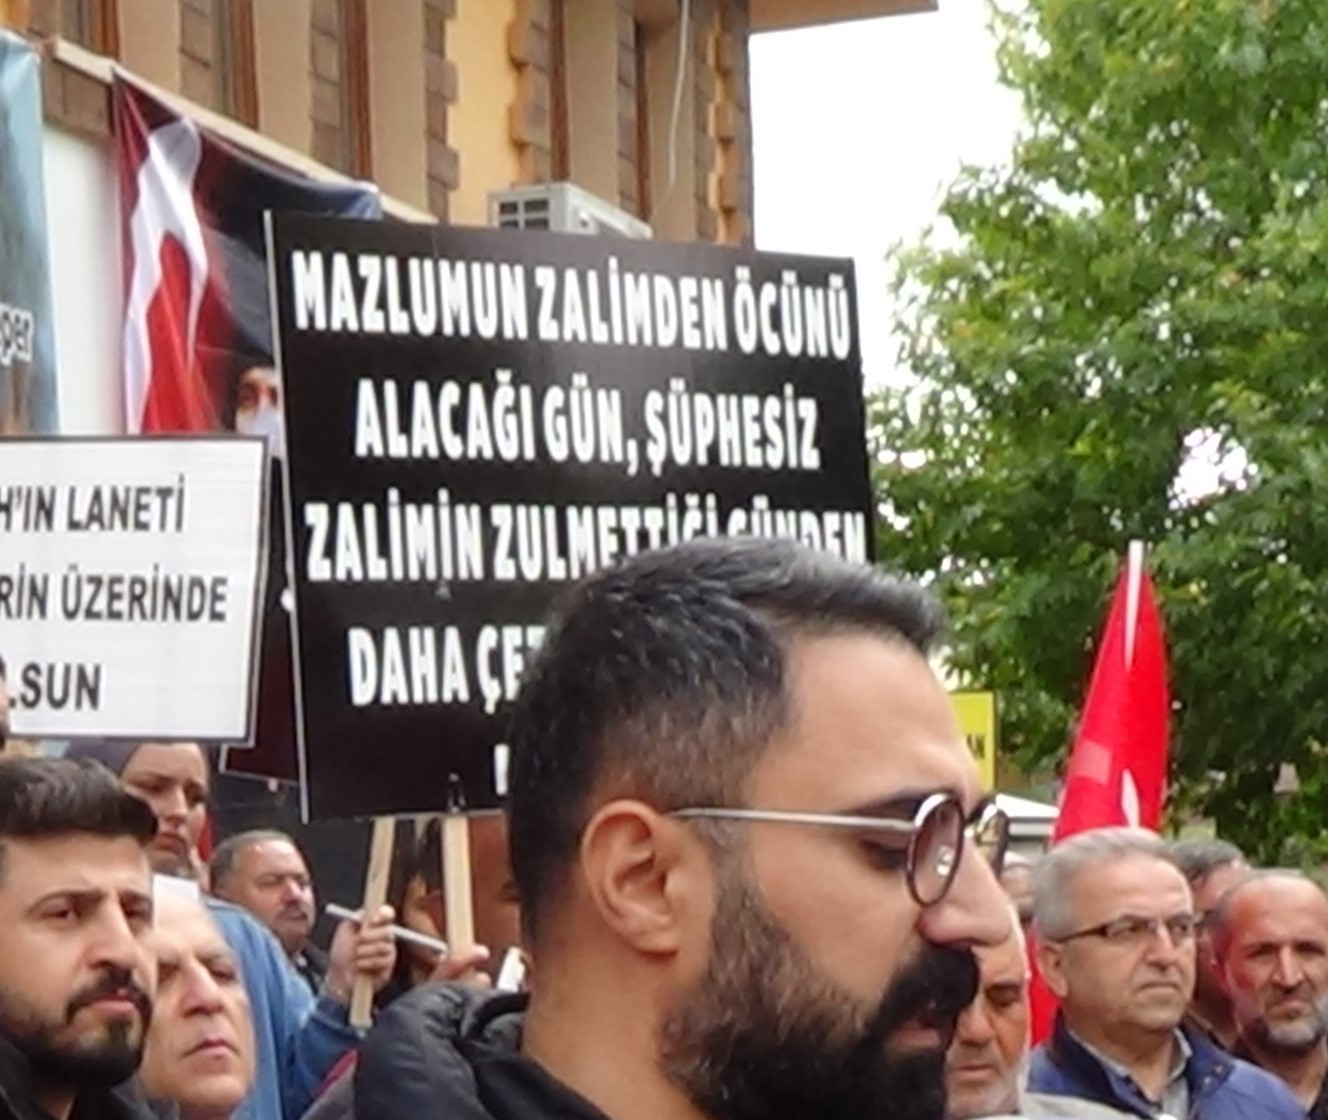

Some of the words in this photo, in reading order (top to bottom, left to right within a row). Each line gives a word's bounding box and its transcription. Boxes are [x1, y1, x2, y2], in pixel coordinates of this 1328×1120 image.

[292, 250, 528, 340] MAZLUMUN
[538, 255, 728, 351] ZALİMDEN
[733, 266, 852, 360] ÖCÜNÜ
[355, 369, 535, 461] ALACAĞI
[543, 373, 638, 476] GÜN,
[645, 377, 821, 477] ŞÜPHESİZ
[66, 473, 186, 533] LANETİ
[304, 487, 484, 582] ZALİMİN
[61, 562, 228, 622] ÜZERİNDE
[8, 661, 102, 711] SUN
[347, 625, 471, 707] DAHA
[476, 624, 548, 716] ÇE
